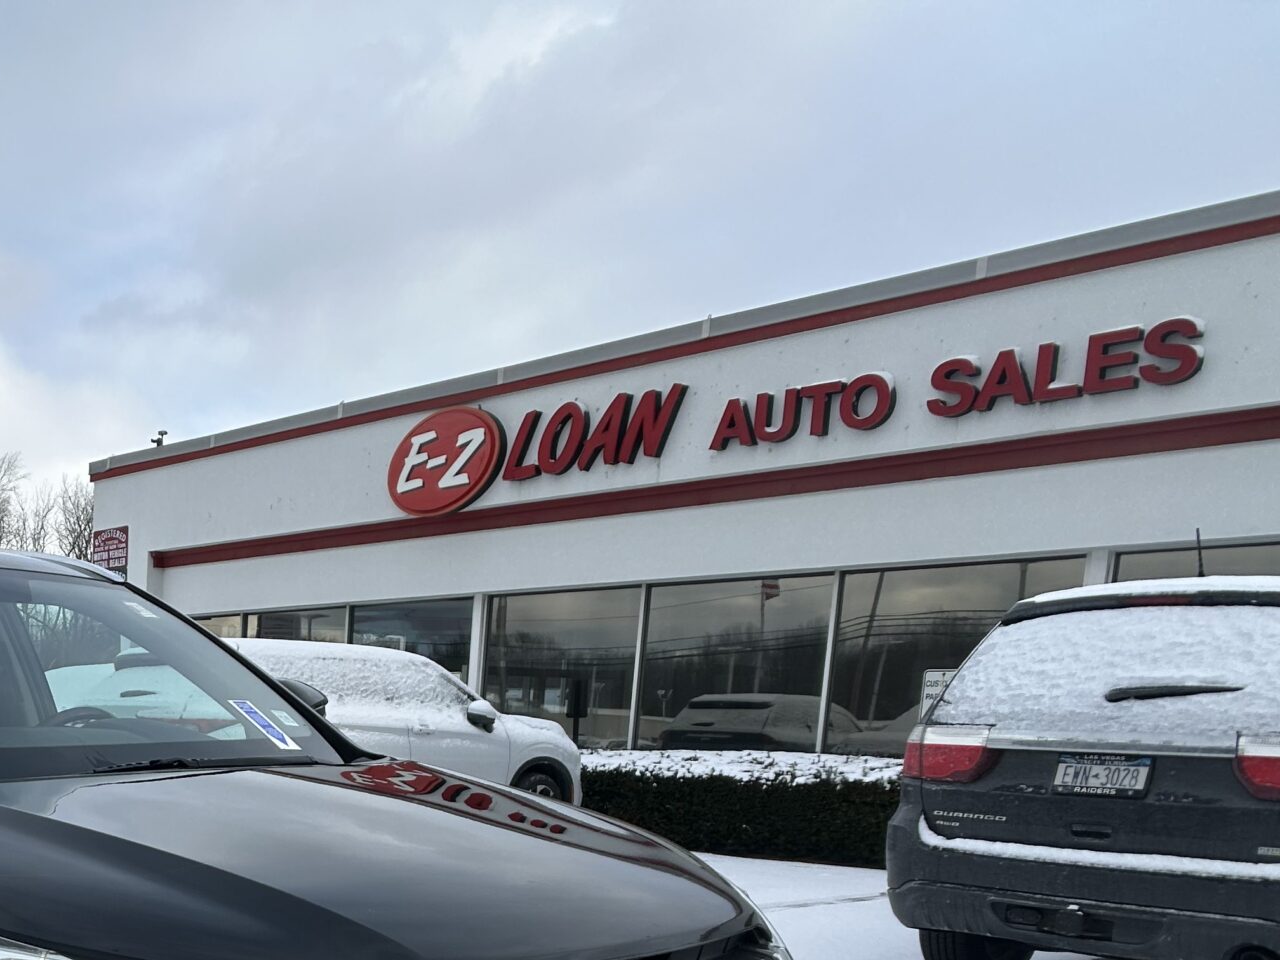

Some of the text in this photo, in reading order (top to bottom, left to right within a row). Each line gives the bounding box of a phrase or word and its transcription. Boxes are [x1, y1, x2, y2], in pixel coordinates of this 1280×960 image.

[395, 315, 1206, 493] E-Z LOAN AUTO SALES
[925, 680, 949, 688] CUSTO
[925, 693, 941, 701] PAR
[1073, 786, 1117, 795] RAIDERS
[933, 810, 1007, 822] DURANGO
